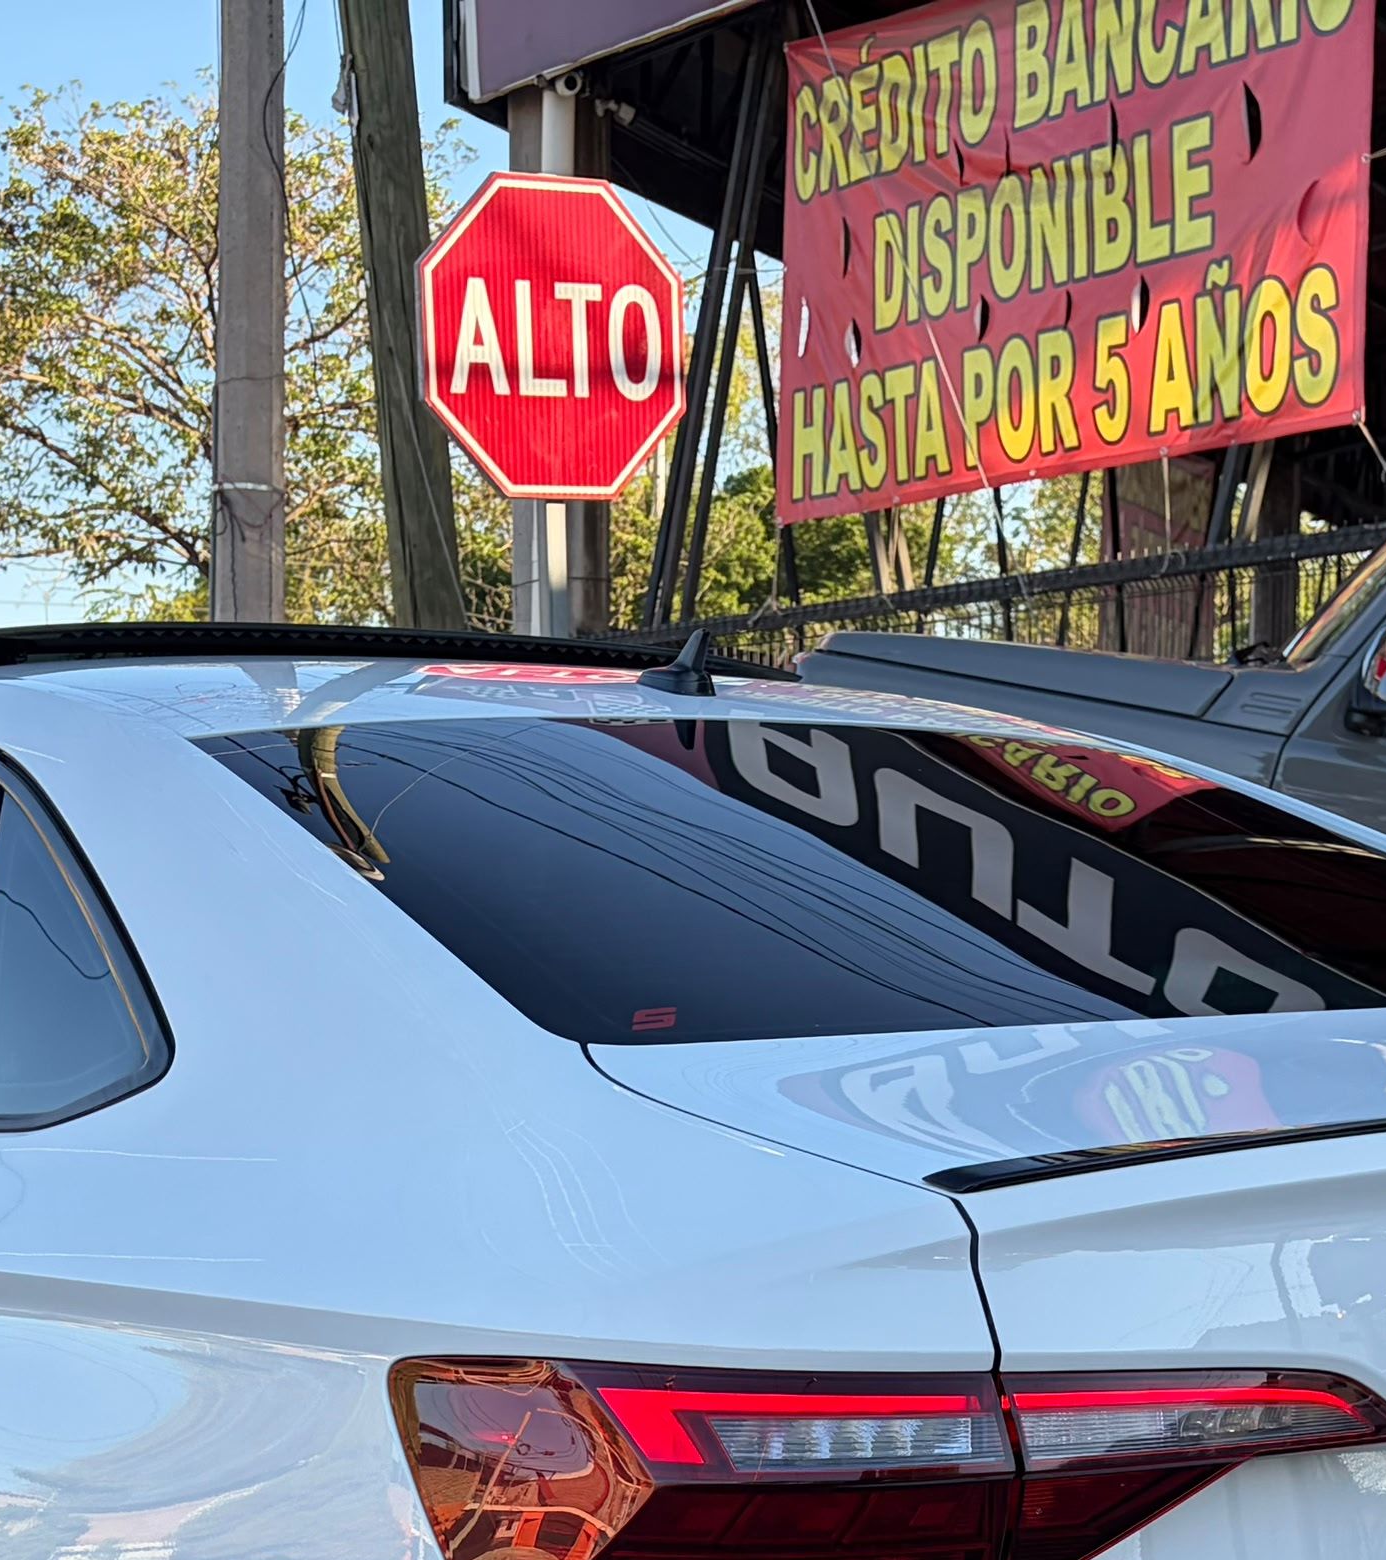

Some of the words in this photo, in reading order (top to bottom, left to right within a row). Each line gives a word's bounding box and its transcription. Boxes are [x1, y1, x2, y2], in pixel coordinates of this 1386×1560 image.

[793, 18, 998, 205] CRÉDITO
[1013, 0, 1355, 132] BANCA
[873, 113, 1216, 333] DISPONIBLE
[450, 277, 662, 402] ALTO
[791, 356, 953, 502] HASTA
[963, 328, 1079, 469] POR
[1093, 313, 1131, 445] 5
[1148, 257, 1340, 435] AÑOS
